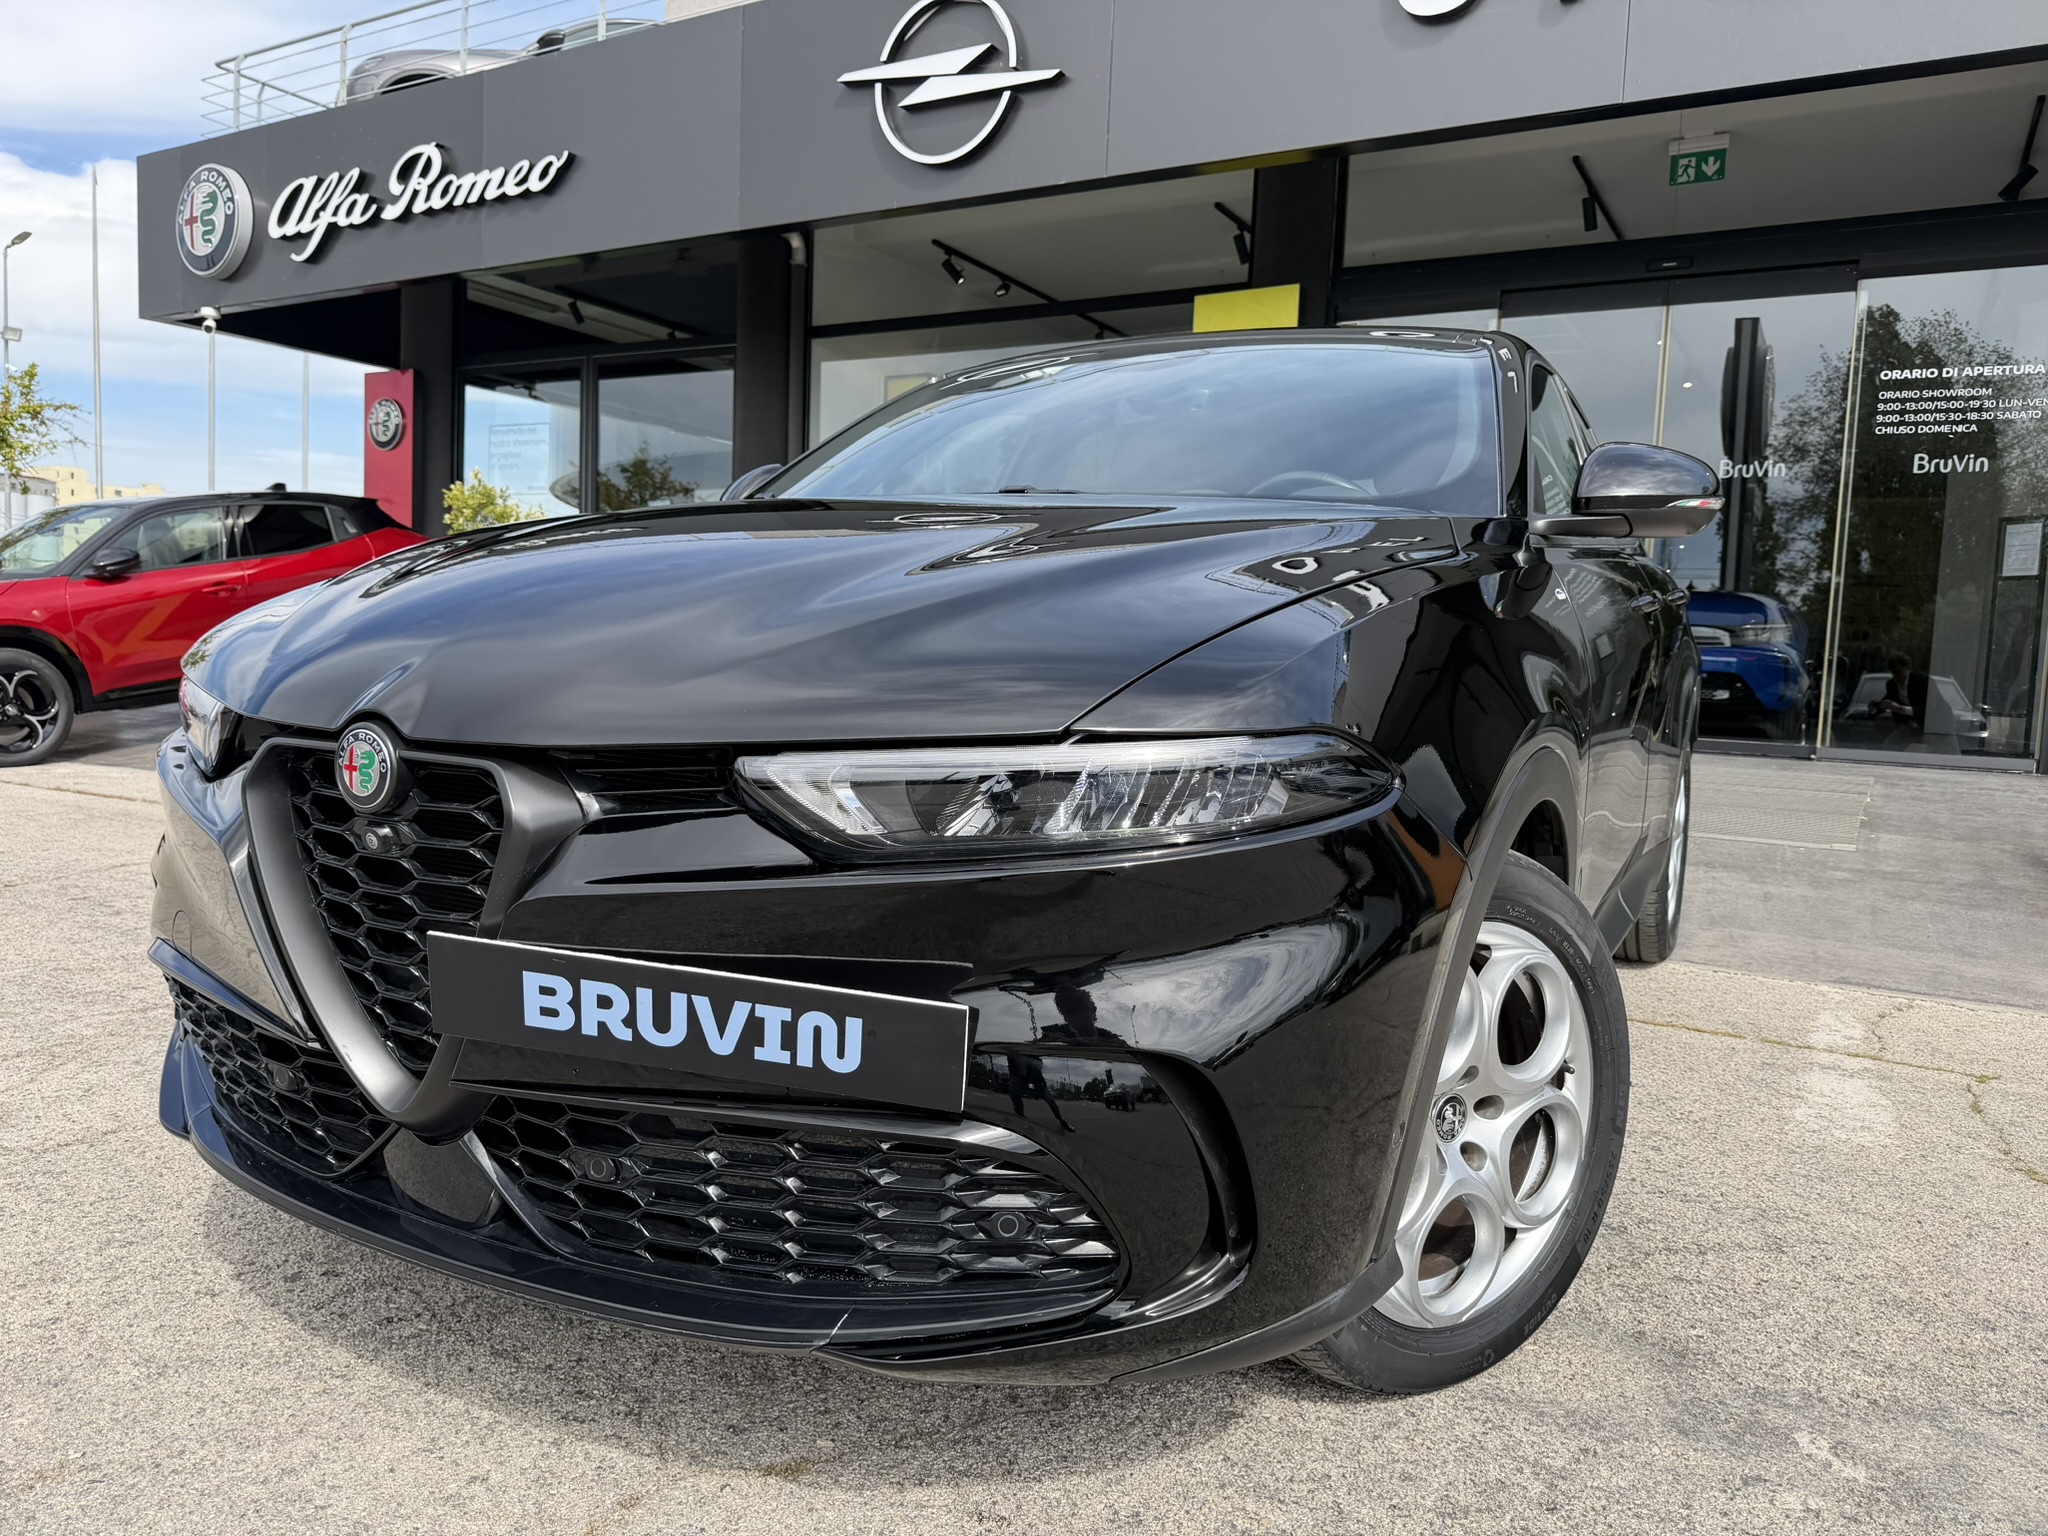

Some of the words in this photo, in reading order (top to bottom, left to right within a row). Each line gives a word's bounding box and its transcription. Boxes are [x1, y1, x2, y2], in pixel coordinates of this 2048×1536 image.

[200, 170, 234, 215] ROMEO
[267, 167, 378, 262] Alfa
[379, 141, 570, 221] Romeo
[1879, 368, 1938, 381] ORARIO
[1941, 367, 1958, 378] DI
[1962, 364, 2046, 377] APERTURA
[1878, 389, 1920, 400] ORARIO
[1922, 387, 1993, 398] SHOWROOM
[1996, 410, 2042, 420] SABATO
[1874, 425, 1916, 435] CHIUSO
[1917, 424, 1978, 434] DOMENICA
[1718, 459, 1786, 479] BruVin
[1912, 453, 1989, 474] BruVin
[338, 735, 355, 766] ALFA
[358, 732, 387, 773] ROMEO
[522, 970, 863, 1074] BRUVIN
